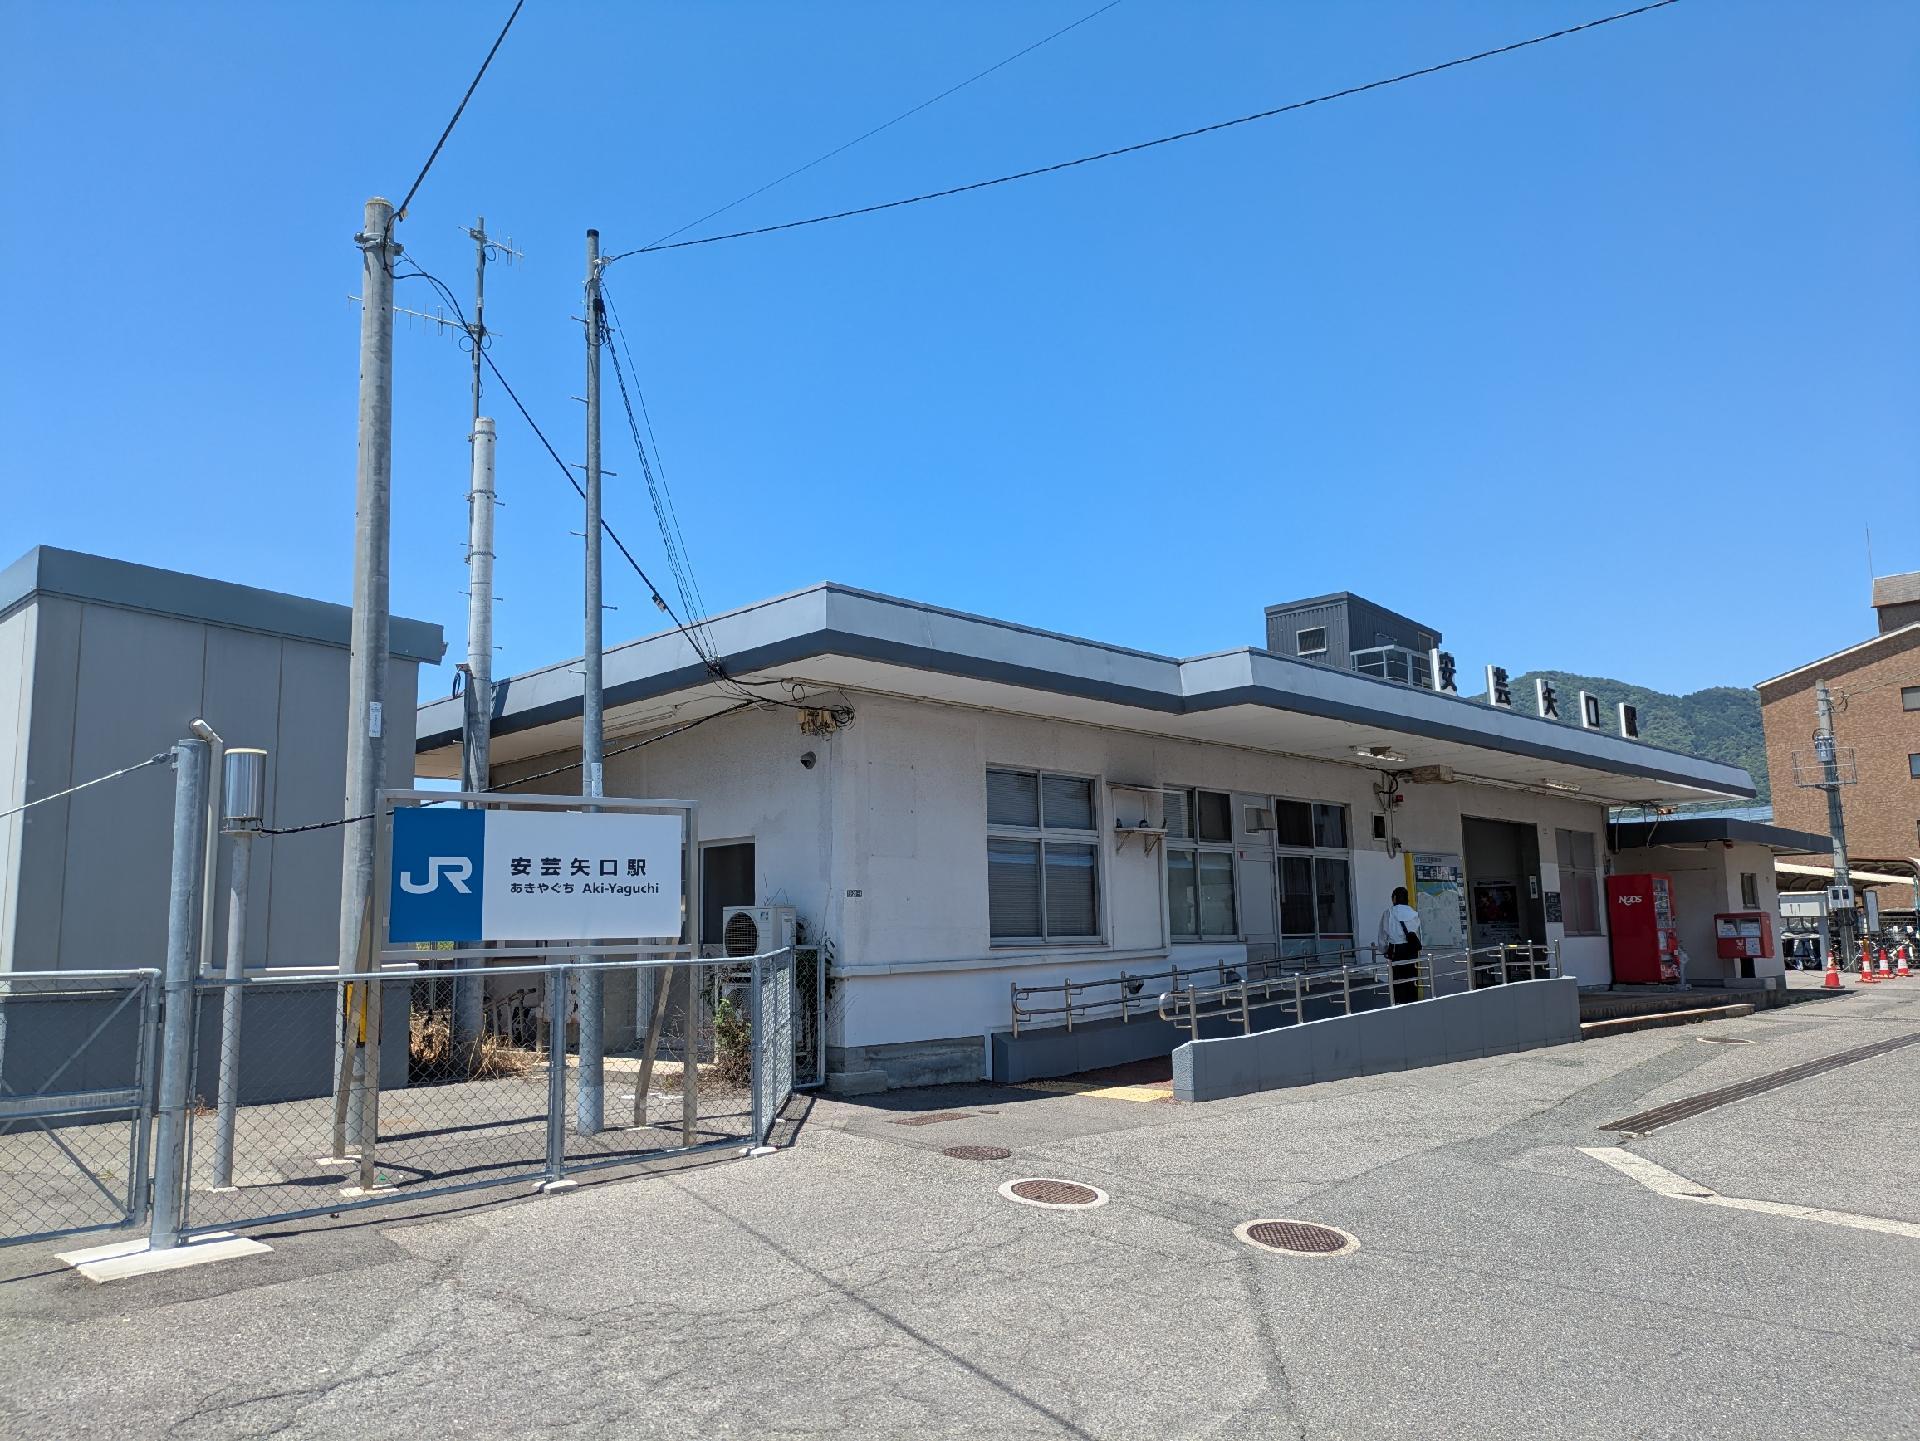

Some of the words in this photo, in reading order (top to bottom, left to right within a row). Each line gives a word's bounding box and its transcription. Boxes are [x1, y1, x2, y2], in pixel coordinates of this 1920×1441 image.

[400, 857, 472, 894] JR
[511, 857, 646, 876] 安芸矢口駅
[511, 882, 574, 894] あきやぐち
[582, 882, 659, 896] Aki-Yaguchi
